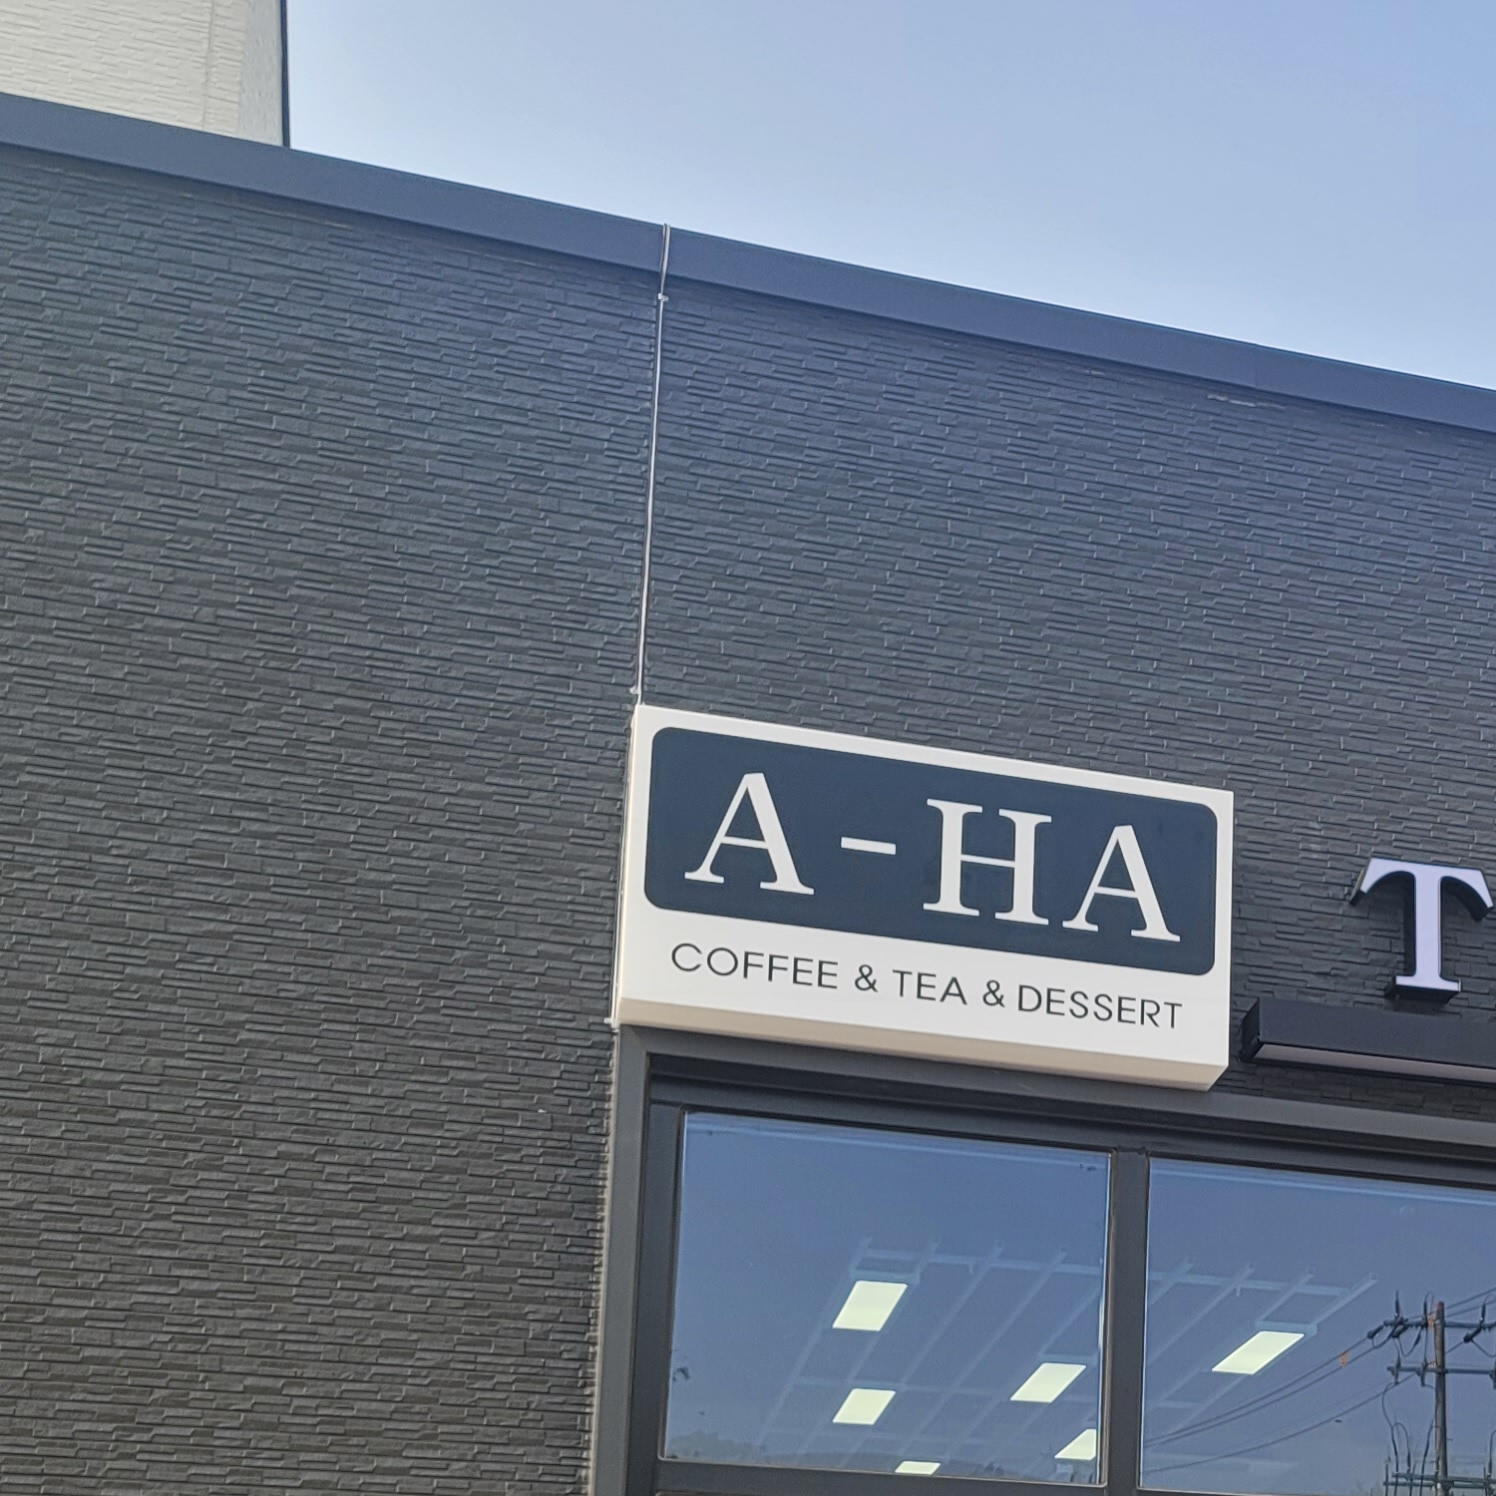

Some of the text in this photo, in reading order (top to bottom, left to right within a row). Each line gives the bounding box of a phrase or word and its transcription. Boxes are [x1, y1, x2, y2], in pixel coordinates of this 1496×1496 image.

[671, 942, 1184, 1030] COFFEE & TEA & DESSERT
